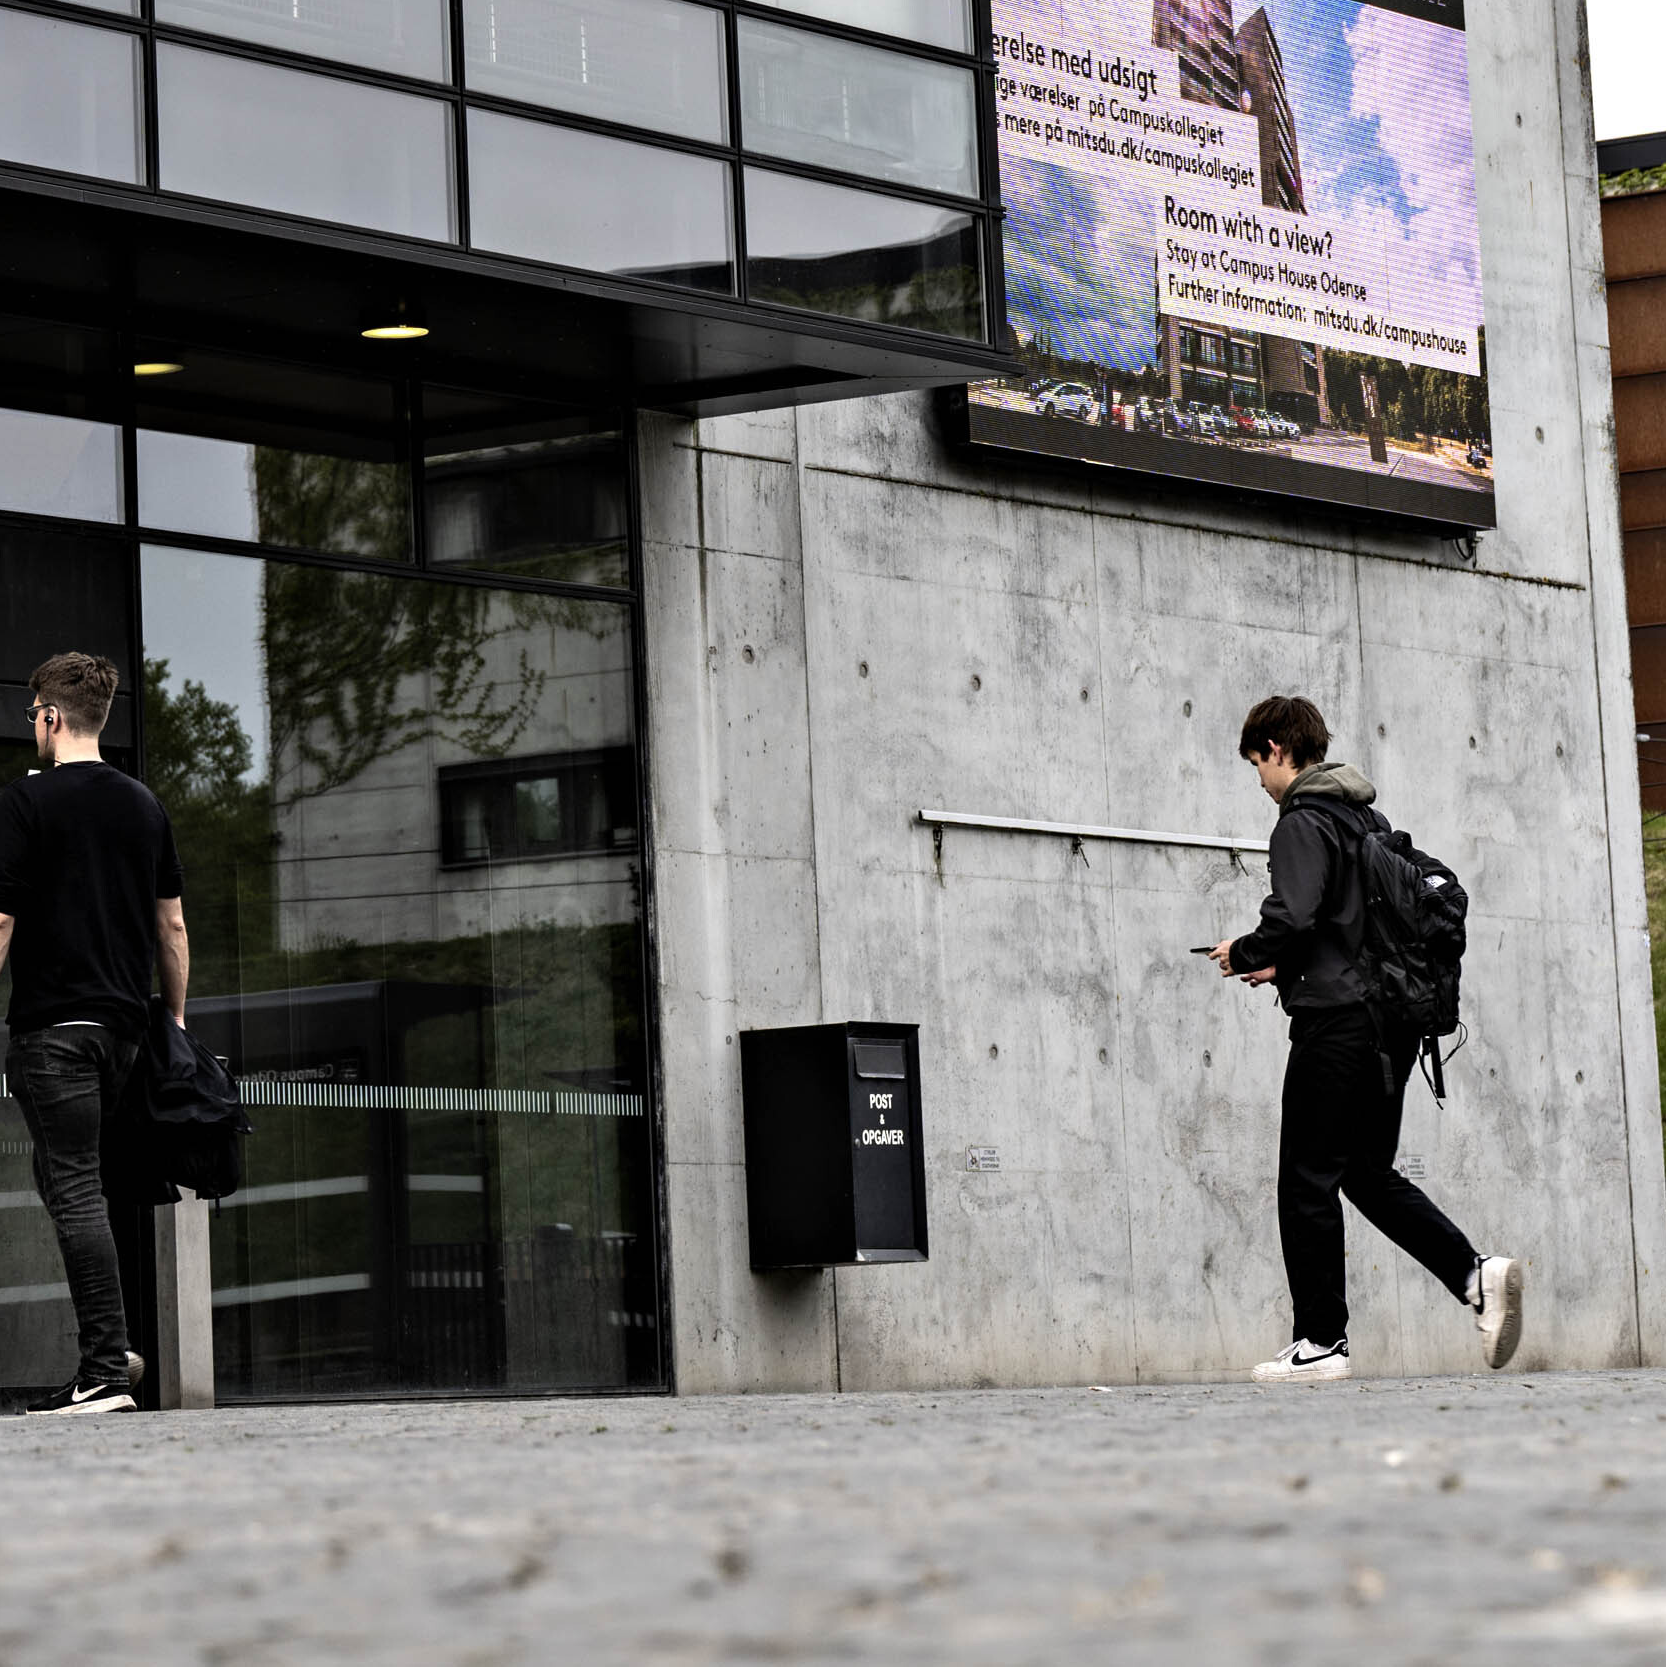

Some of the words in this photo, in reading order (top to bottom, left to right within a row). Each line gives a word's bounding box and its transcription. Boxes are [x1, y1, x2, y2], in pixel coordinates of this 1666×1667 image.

[1052, 49, 1092, 79] med
[1098, 56, 1157, 102] udsigt
[1020, 83, 1081, 112] værelser
[1089, 93, 1106, 122] på
[1109, 98, 1225, 148] Campuskollegiet
[1005, 113, 1041, 138] mere
[1045, 117, 1063, 144] på
[1066, 125, 1256, 189] mitsdu.dk/campuskollegiet
[1165, 195, 1218, 235] Room
[1222, 211, 1264, 245] with
[1269, 226, 1280, 248] a
[1284, 224, 1333, 260] view?
[1166, 238, 1198, 272] Stay
[1201, 249, 1217, 271] at
[1219, 249, 1275, 285] Campus
[1278, 261, 1318, 291] House
[1320, 271, 1367, 302] Odense
[1168, 273, 1219, 305] Further
[1222, 285, 1307, 323] information:
[1314, 305, 1467, 356] mitsdu.dk/campushouse
[869, 1093, 893, 1109] POST
[862, 1129, 905, 1146] OPGAVER
